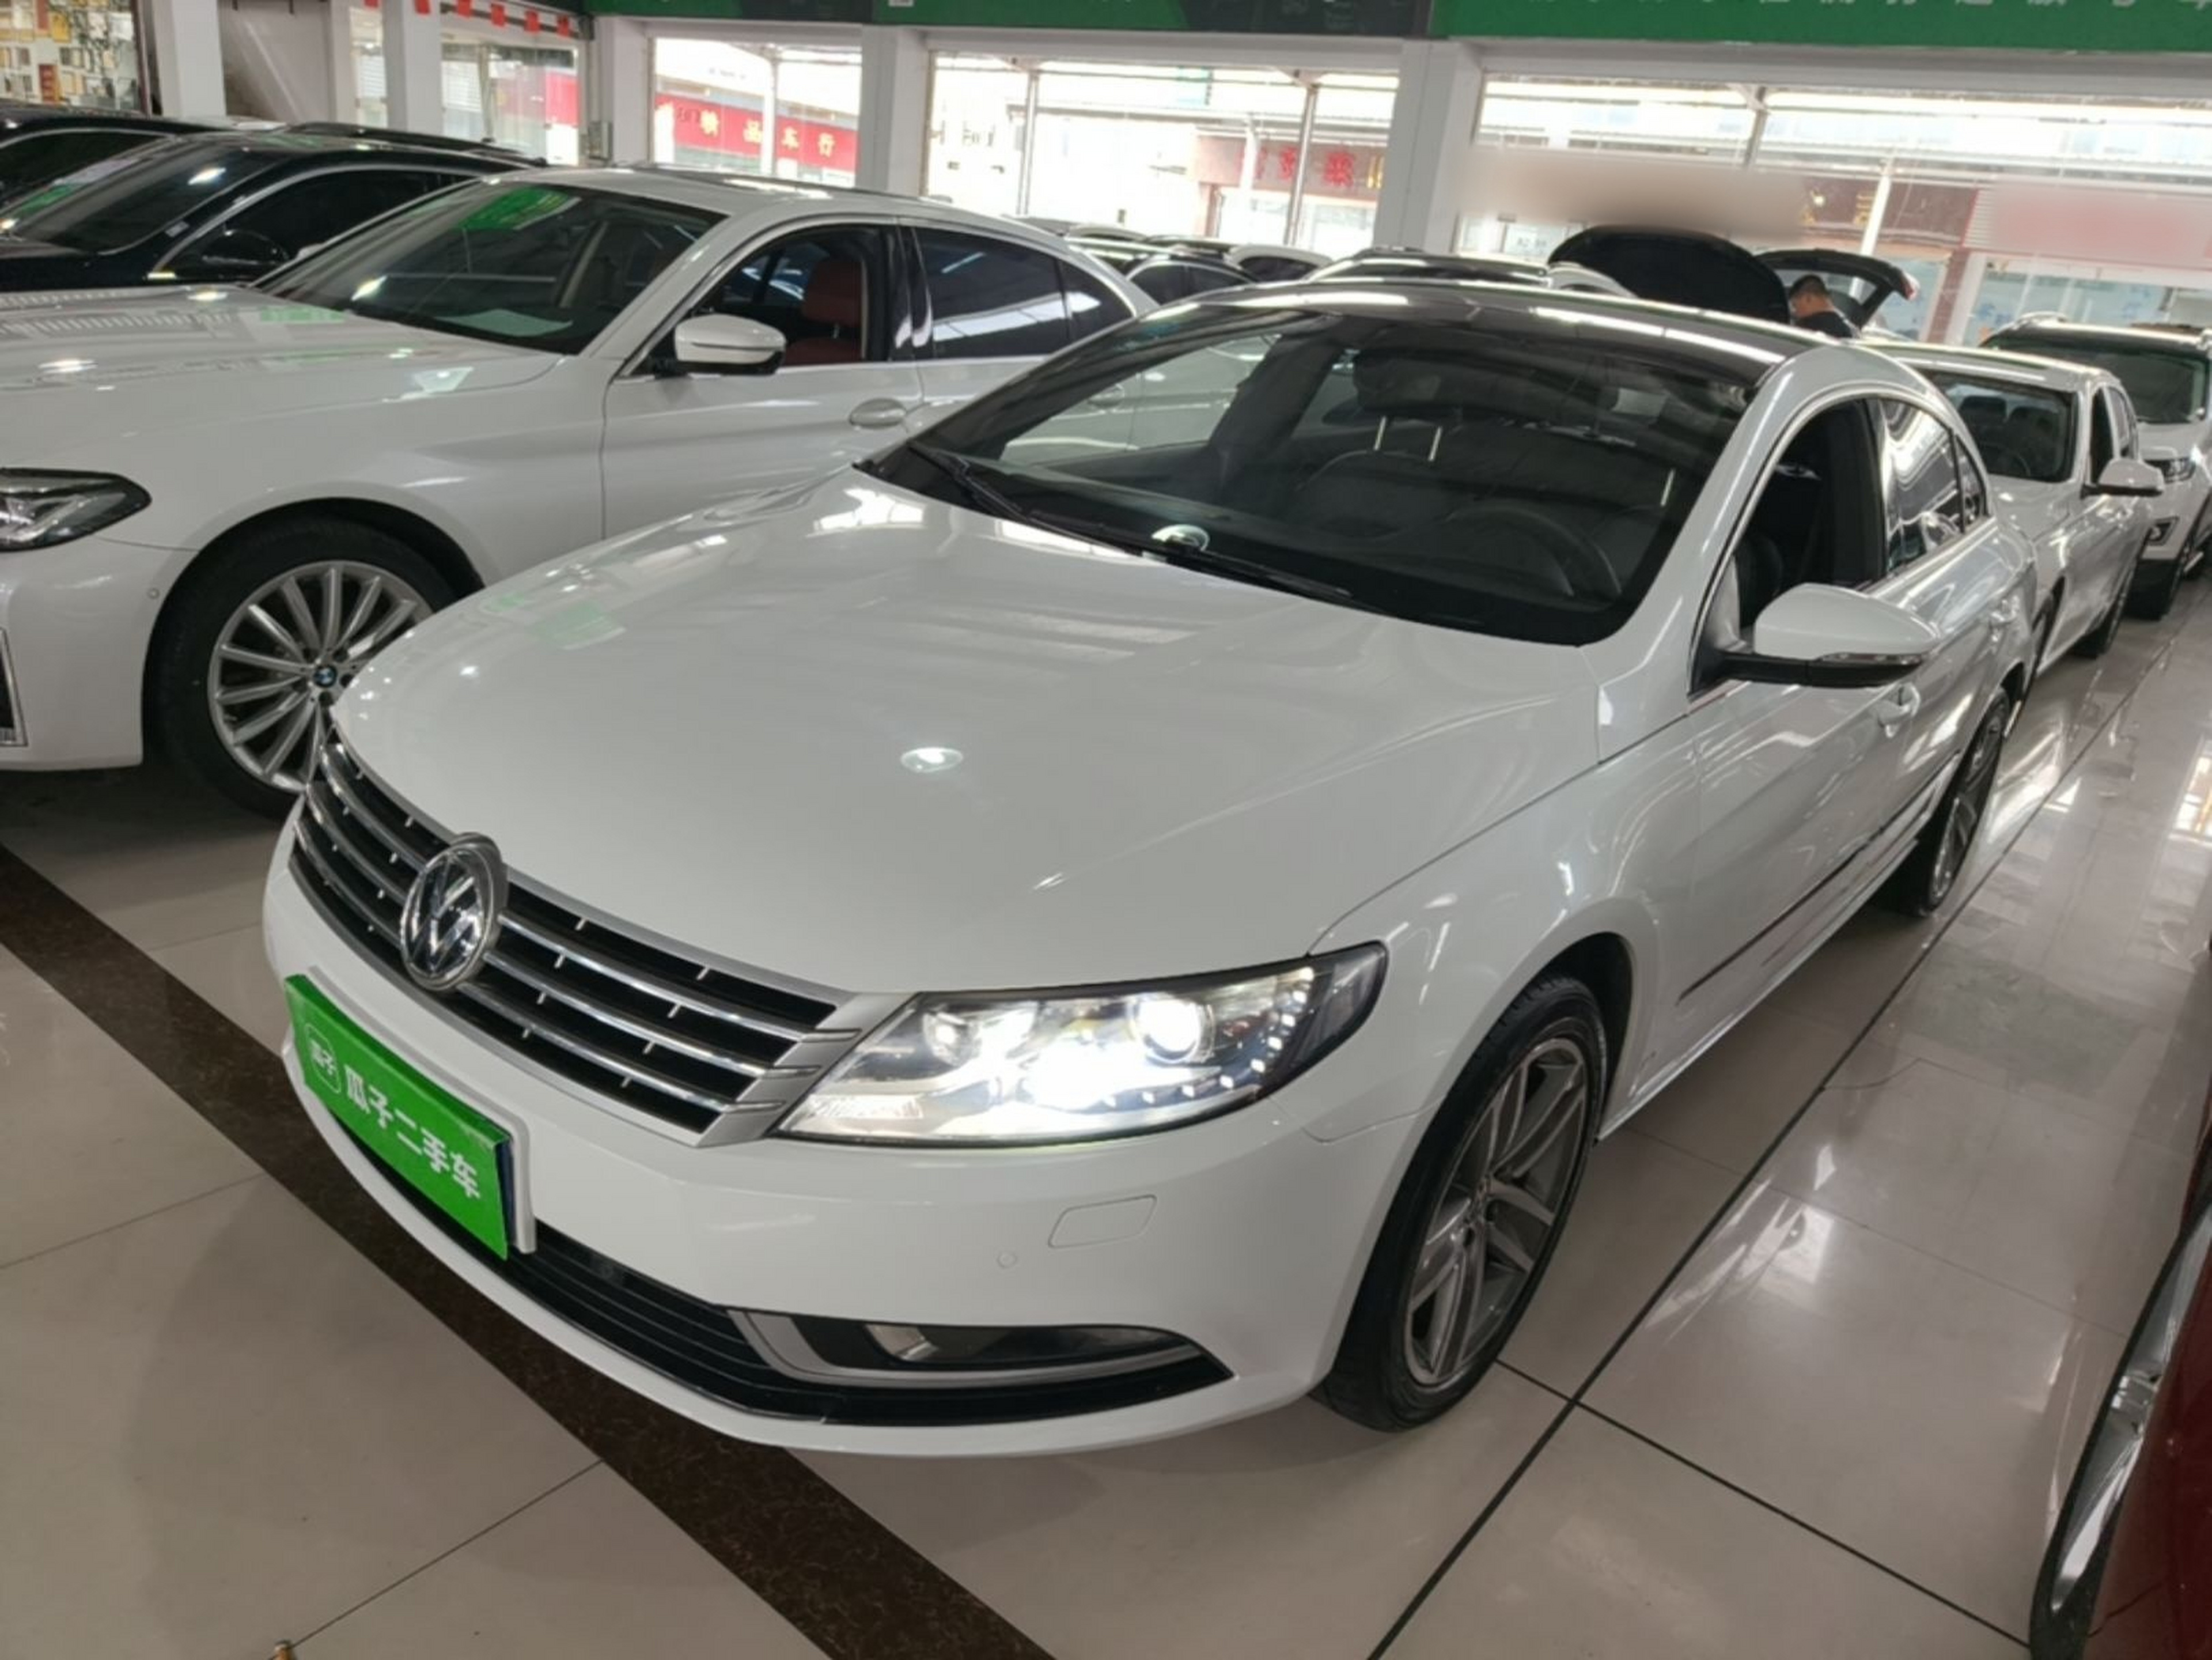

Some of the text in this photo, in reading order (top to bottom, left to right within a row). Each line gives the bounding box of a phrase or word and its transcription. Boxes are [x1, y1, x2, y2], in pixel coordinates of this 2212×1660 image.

[345, 1064, 480, 1198] 瓜子二手车
